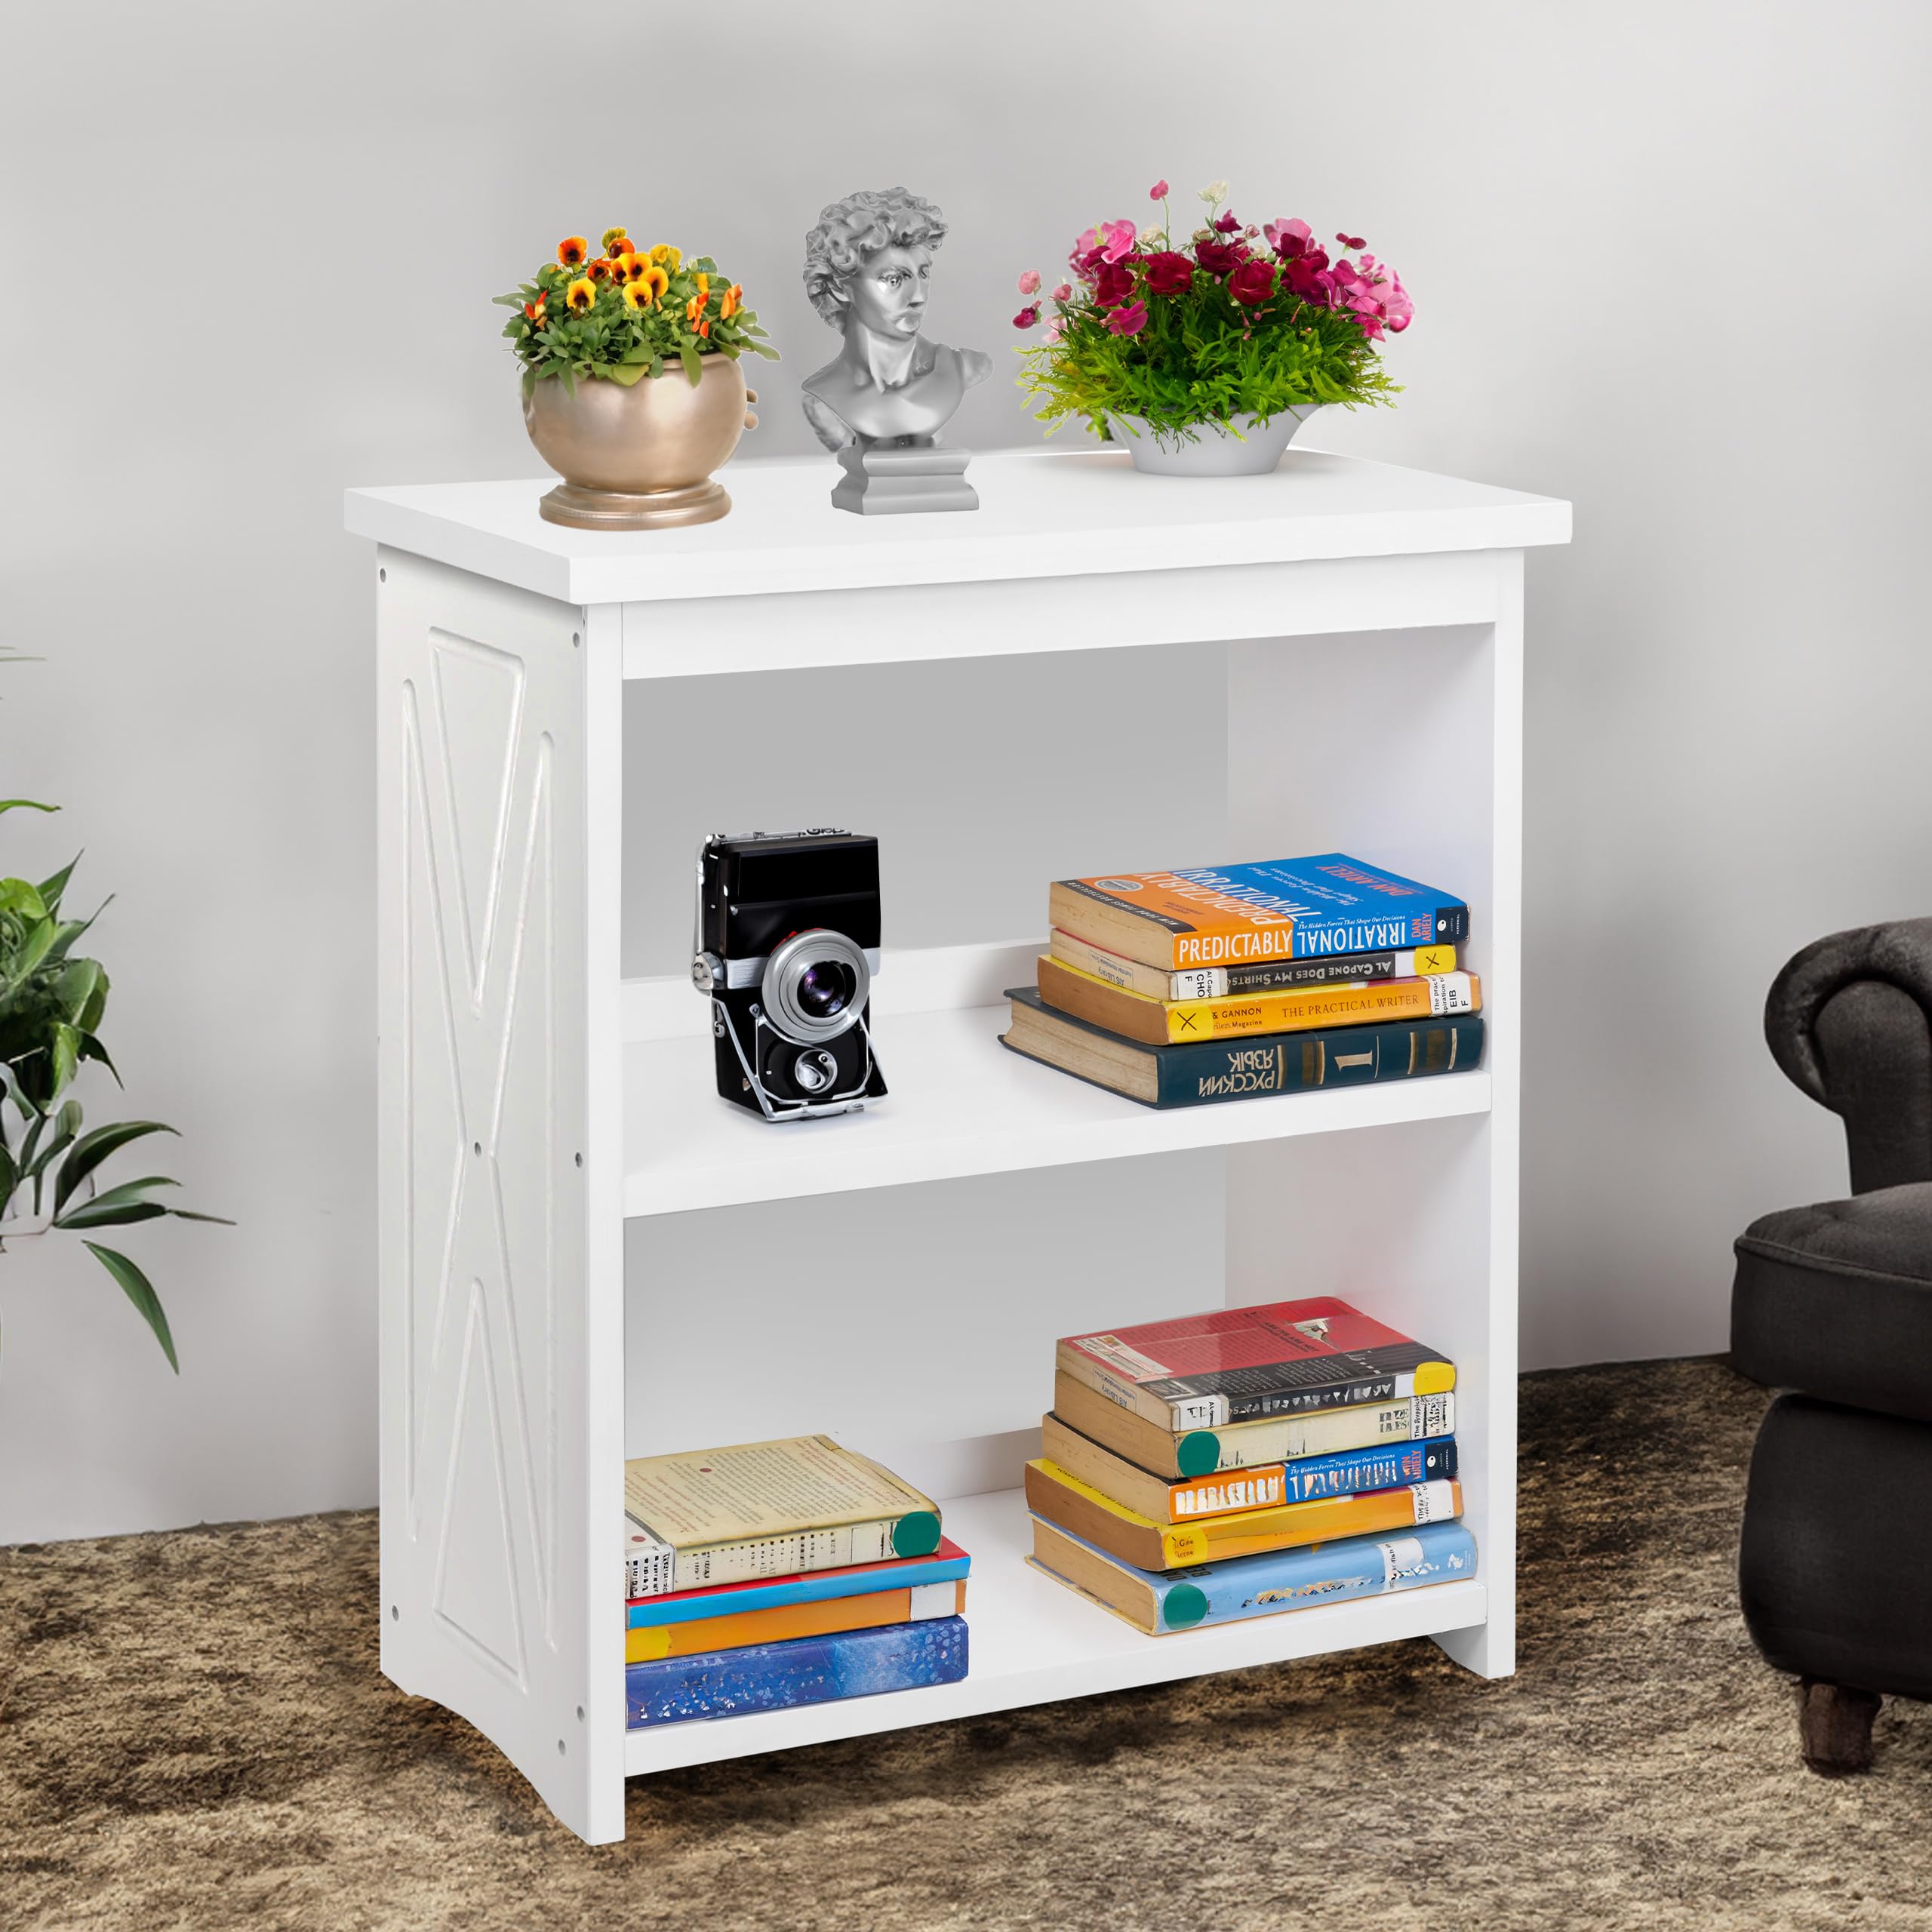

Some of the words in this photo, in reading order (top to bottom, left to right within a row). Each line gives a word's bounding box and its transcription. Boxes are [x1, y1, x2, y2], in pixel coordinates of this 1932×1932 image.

[1315, 865, 1375, 885] ARIELY
[1134, 873, 1291, 925] PREDICTABLY
[1171, 869, 1322, 922] IRRATIONAL
[1367, 883, 1414, 897] DAN
[1308, 921, 1327, 929] Hidden
[1327, 919, 1344, 928] Forces
[1355, 917, 1371, 925] Shape
[1411, 918, 1422, 939] DAN
[1421, 912, 1432, 942] ARIELY
[1178, 929, 1293, 963] PREDICTABLY
[1297, 921, 1406, 955] IRRATIONAL
[1274, 971, 1293, 983] MY
[1296, 965, 1325, 980] DOES
[1328, 964, 1373, 977] CAPONE
[1375, 961, 1392, 974] AL
[1196, 974, 1206, 998] CHO
[1232, 974, 1272, 986] SHIRTS
[1282, 1007, 1306, 1018] THE
[1308, 1000, 1374, 1015] PRACTICAL
[1376, 995, 1419, 1008] WRITER
[1449, 989, 1457, 1008] EIB
[1221, 1007, 1262, 1018] GANNON
[1232, 1020, 1263, 1029] Magazine
[1227, 1048, 1275, 1072] ЯЗЫК
[1199, 1069, 1275, 1097] РУССКИЙ
